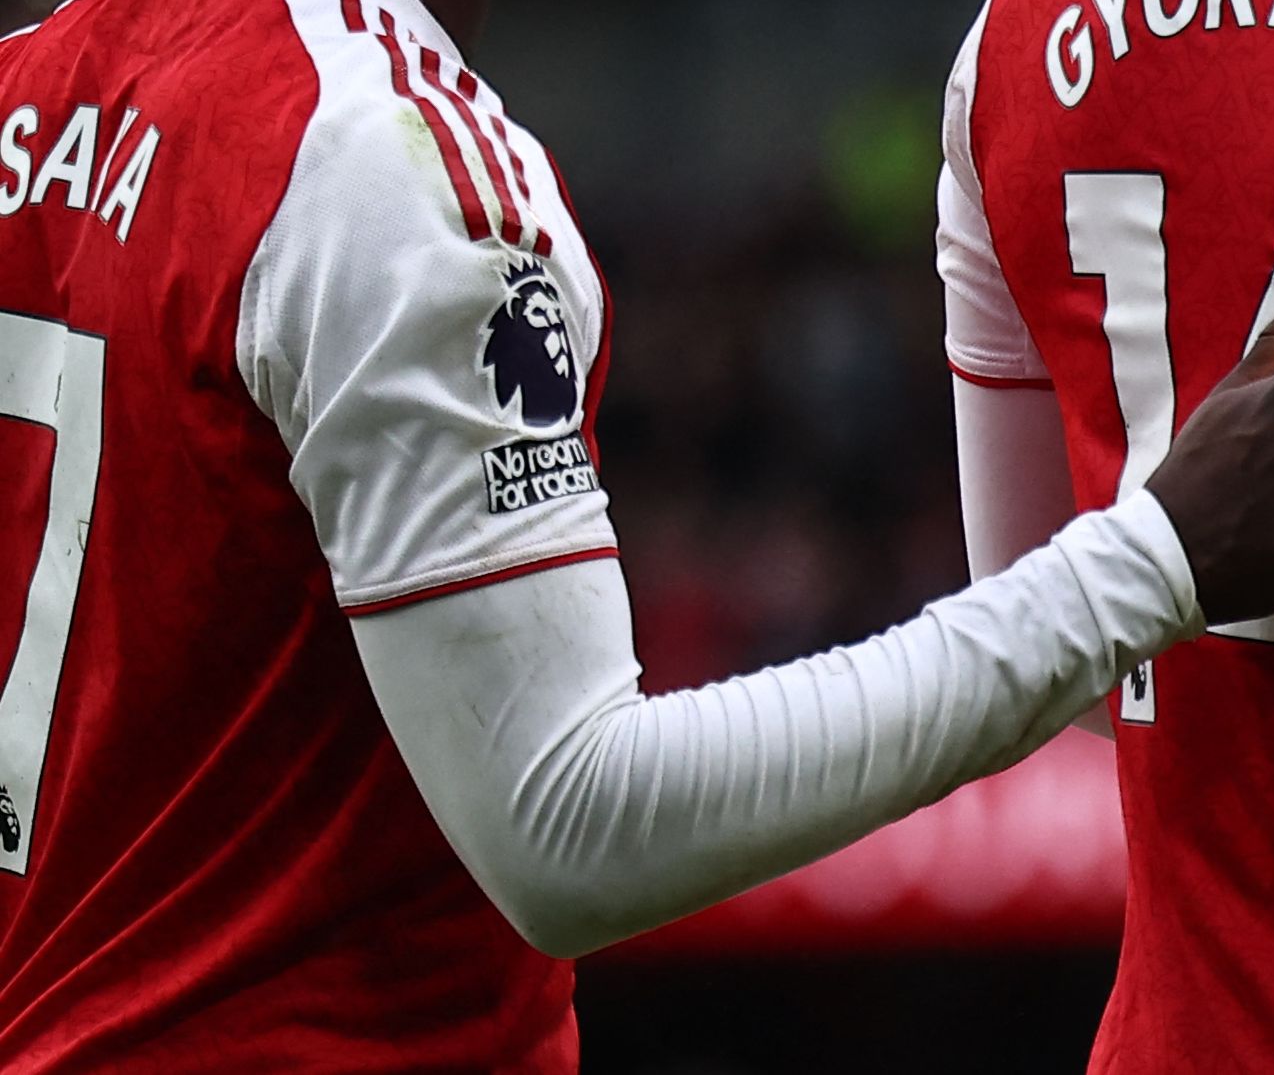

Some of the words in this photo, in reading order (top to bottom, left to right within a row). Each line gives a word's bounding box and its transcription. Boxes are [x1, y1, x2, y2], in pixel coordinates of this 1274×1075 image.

[483, 447, 525, 483] No
[527, 437, 588, 474] room
[489, 479, 528, 513] For
